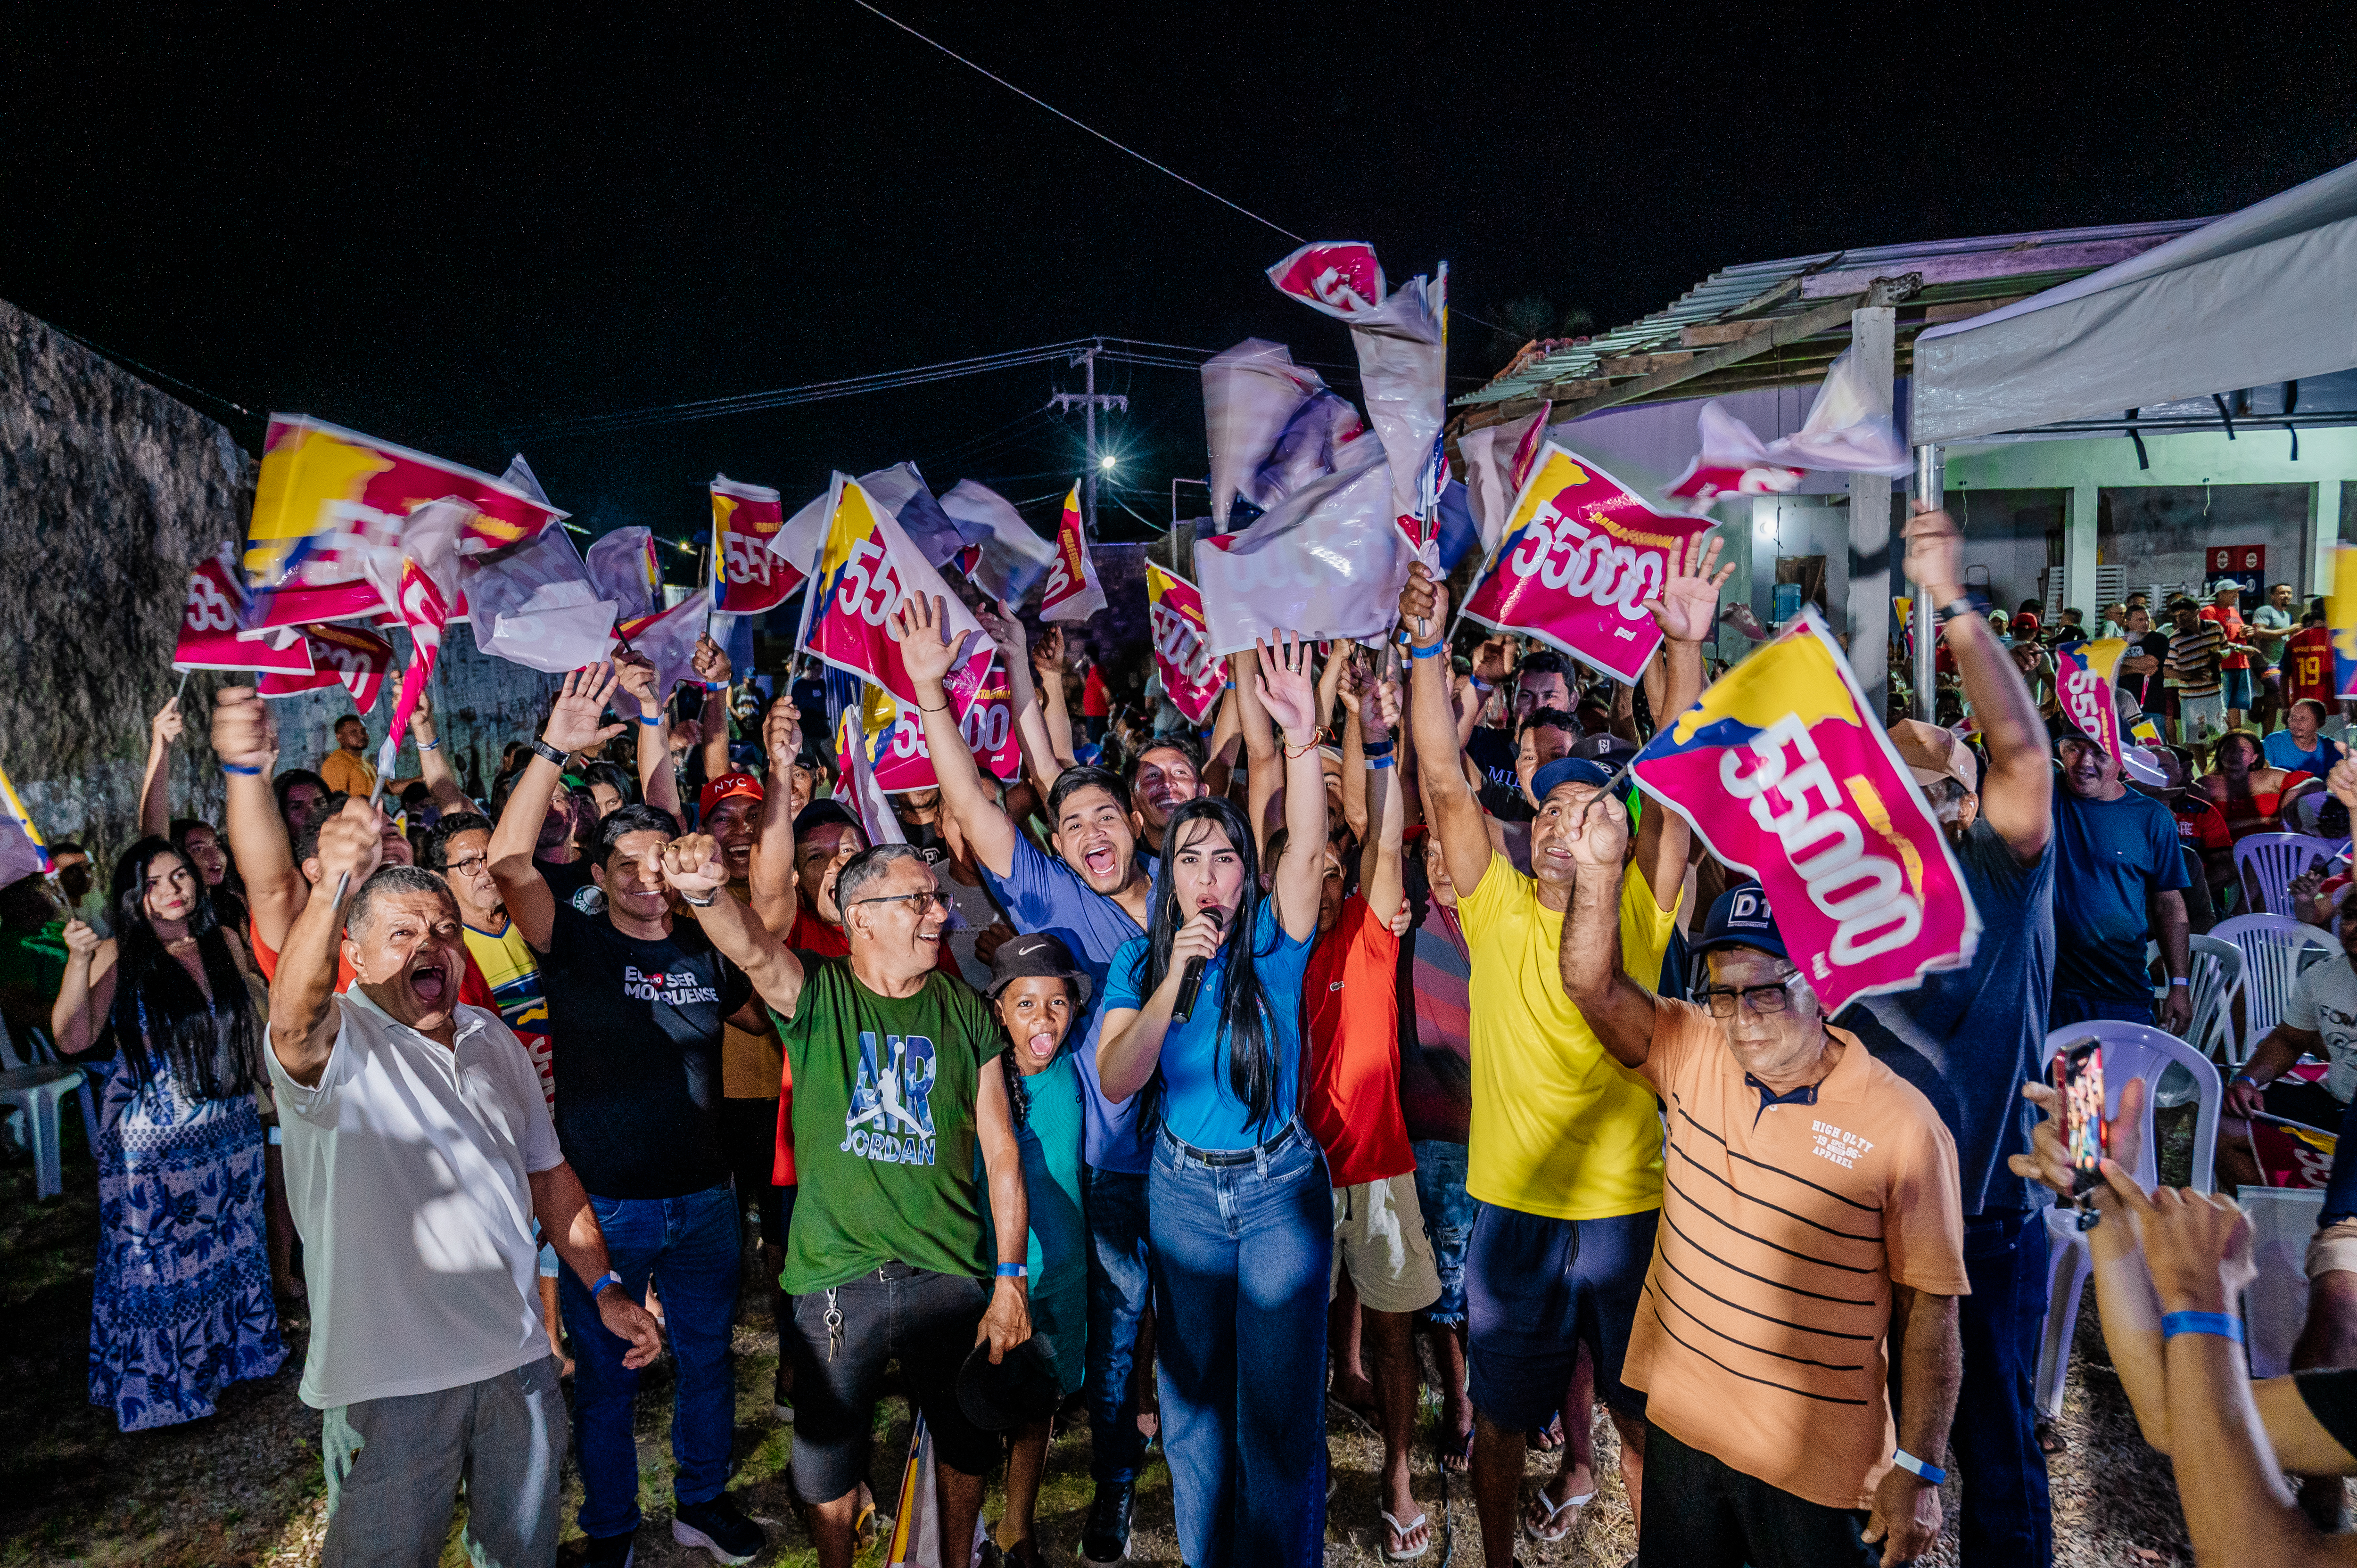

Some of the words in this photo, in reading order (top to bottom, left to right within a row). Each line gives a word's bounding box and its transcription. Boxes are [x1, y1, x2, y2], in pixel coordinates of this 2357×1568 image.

[1511, 500, 1663, 620] 55000
[2296, 657, 2320, 685] 19
[991, 754, 1005, 763] psd
[715, 778, 747, 793] NYC
[1719, 712, 1923, 967] 55000
[666, 972, 698, 988] SER
[847, 1031, 936, 1135] AIR
[1812, 1120, 1841, 1139] HIGH
[840, 1127, 935, 1166] JORDAN
[1812, 1146, 1853, 1169] APPAREL
